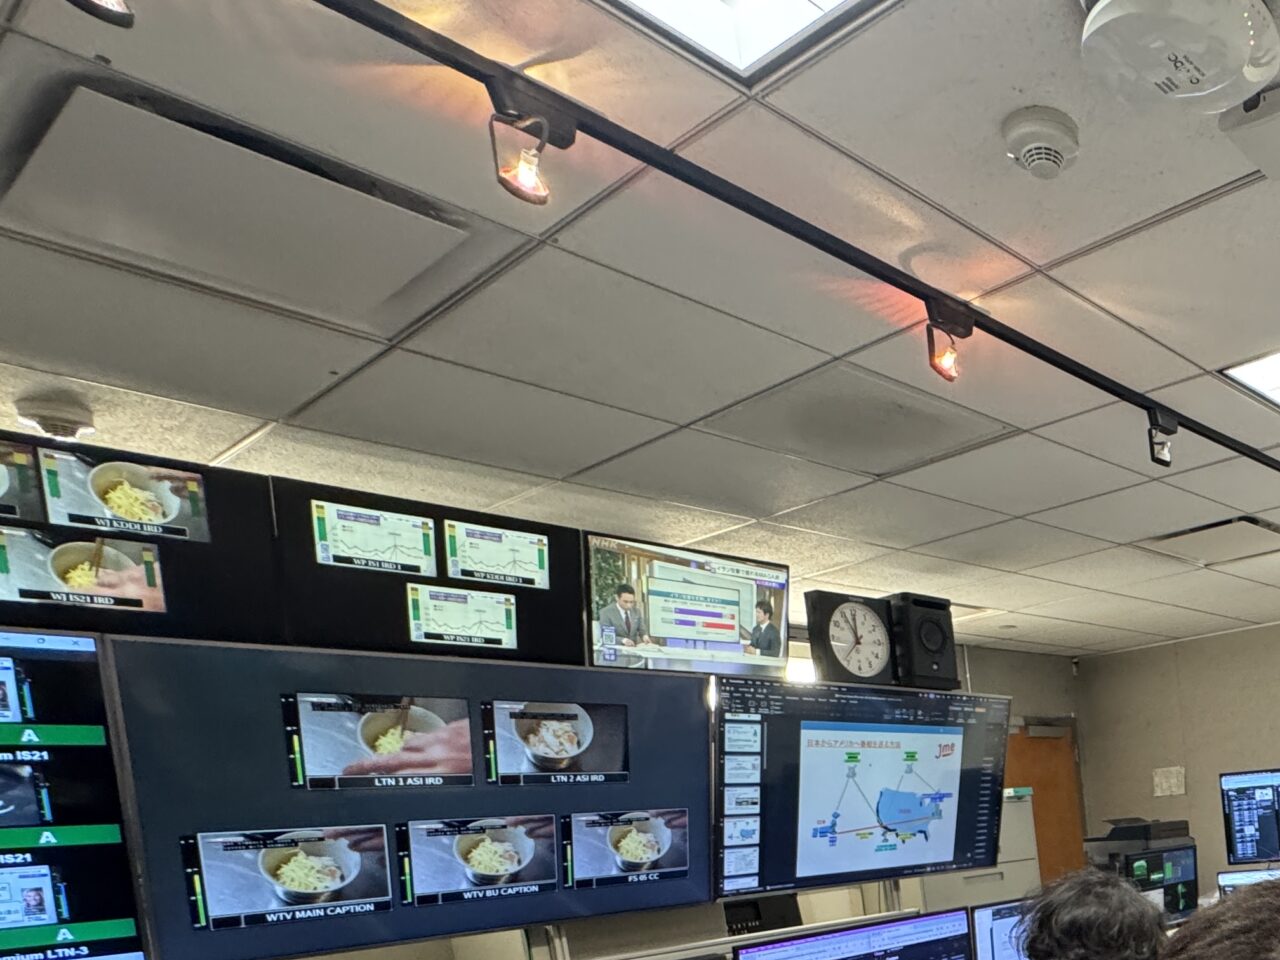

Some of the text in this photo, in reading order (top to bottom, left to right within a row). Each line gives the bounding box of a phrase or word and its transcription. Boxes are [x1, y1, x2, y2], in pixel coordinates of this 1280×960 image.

[113, 520, 141, 531] KDDI
[142, 524, 163, 533] IRD
[94, 596, 115, 605] IRD
[21, 729, 40, 742] A
[16, 750, 49, 761] IS21
[374, 777, 397, 786] LTN
[406, 776, 424, 785] ASI
[425, 776, 444, 785] IRD
[551, 774, 567, 783] LTN
[575, 774, 589, 782] ASI
[591, 774, 605, 782] IRD
[39, 831, 58, 844] A
[628, 873, 637, 882] FS
[463, 884, 540, 900] WTV BU CAPTION
[265, 902, 374, 923] WTV MAIN CAPTION
[56, 928, 75, 941] A
[47, 946, 89, 959] LTN-3
